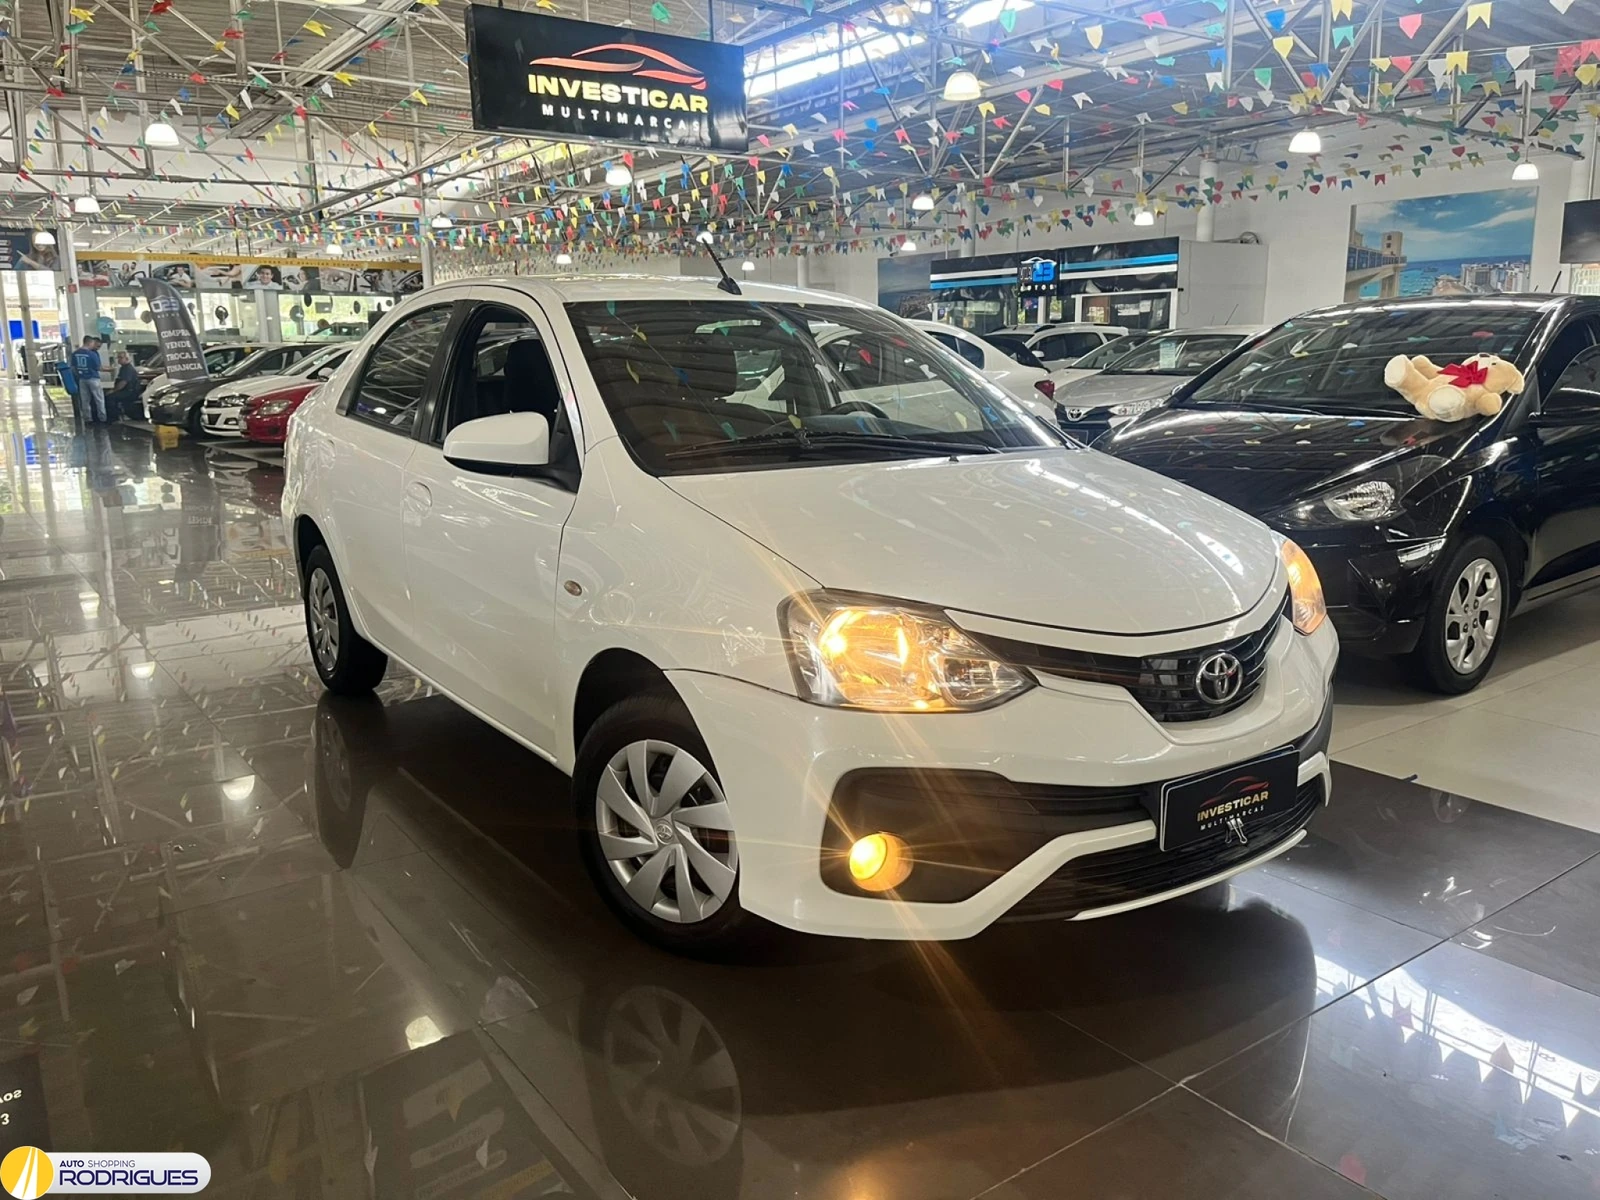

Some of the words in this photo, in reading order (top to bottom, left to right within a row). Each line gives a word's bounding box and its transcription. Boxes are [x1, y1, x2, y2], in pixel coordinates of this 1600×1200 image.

[528, 74, 709, 113] INVESTICAR
[541, 104, 700, 131] MULTIMARCAS
[161, 329, 190, 338] COMPRA
[165, 341, 191, 349] VENDE
[166, 353, 190, 361] TROCA
[167, 363, 203, 373] FINANCIA
[1197, 791, 1269, 821] INVESTICAR
